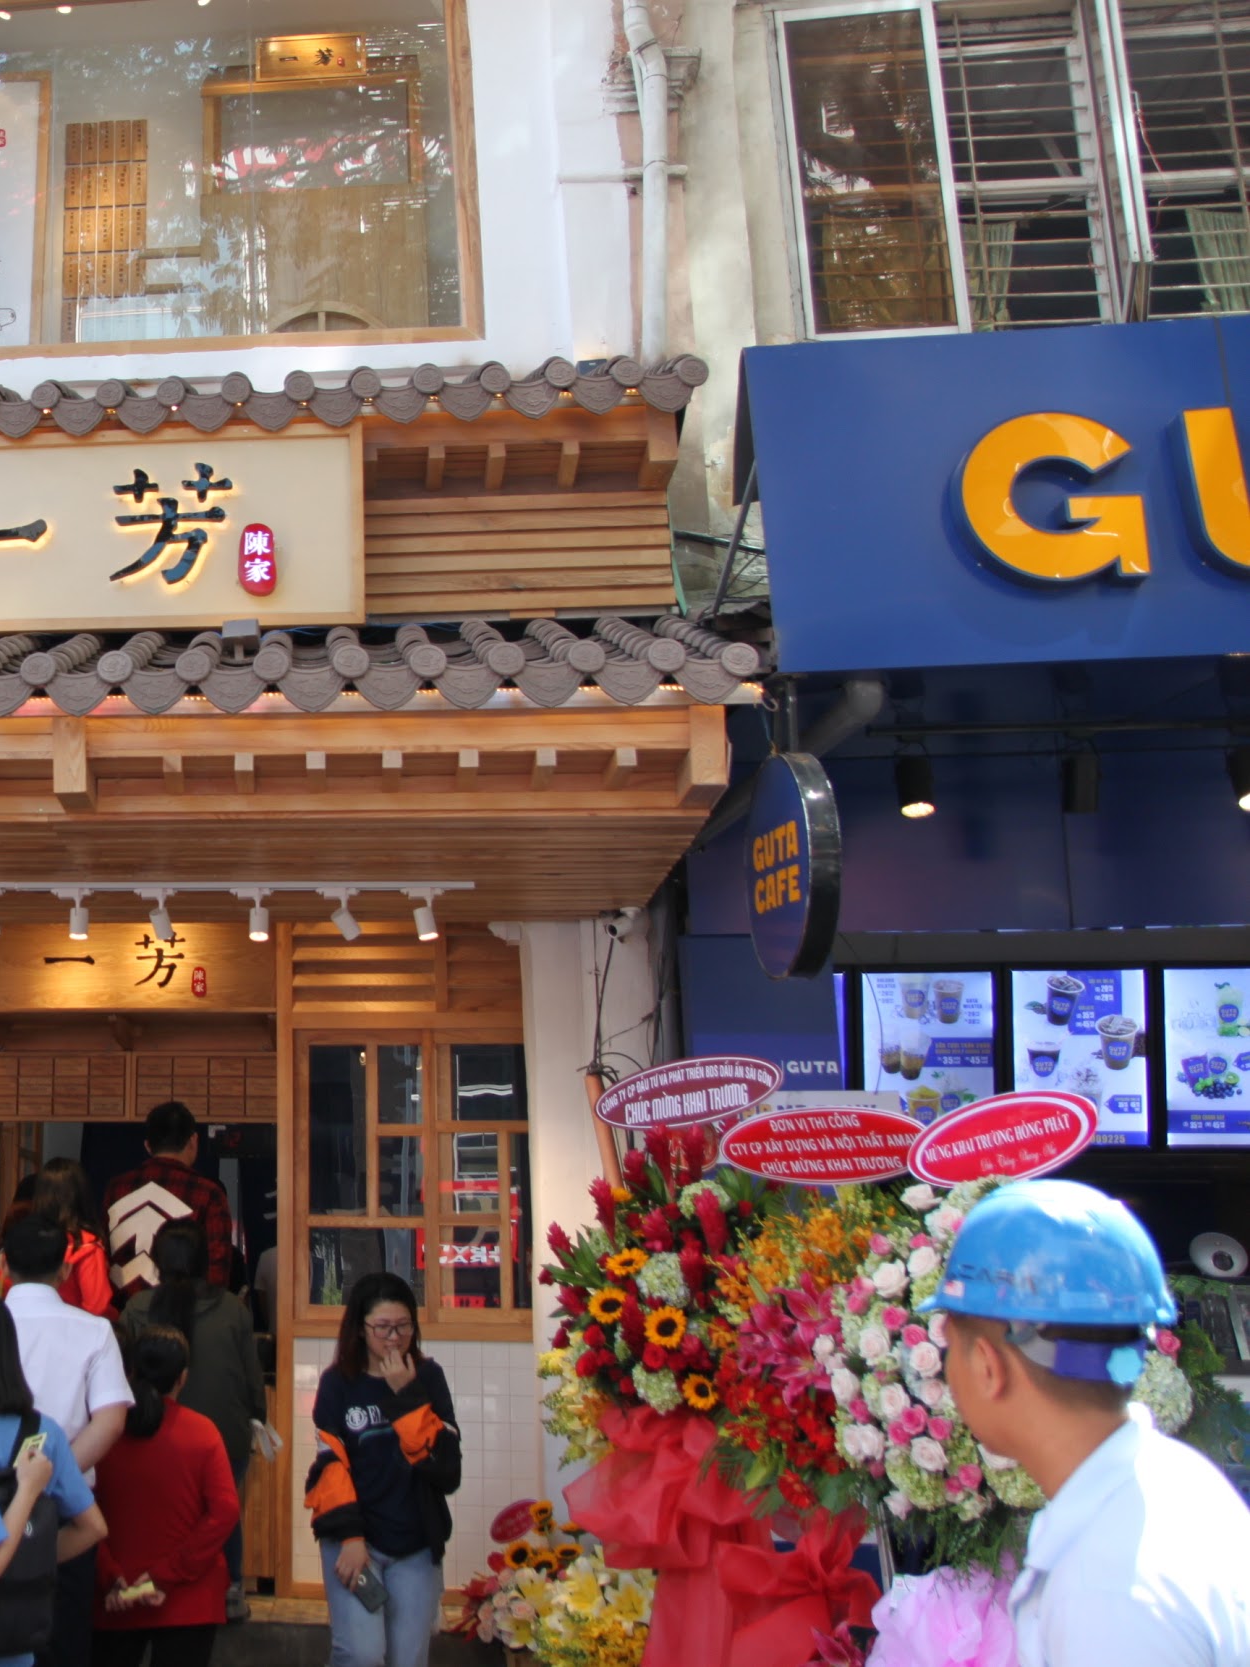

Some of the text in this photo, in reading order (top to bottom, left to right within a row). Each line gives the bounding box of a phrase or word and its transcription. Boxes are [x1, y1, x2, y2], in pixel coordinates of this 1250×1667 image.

[243, 530, 271, 583] 陳家
[753, 820, 798, 872] GUTA
[755, 864, 802, 914] CAFE
[44, 932, 186, 988] 一芳
[786, 1060, 839, 1074] GUTA
[601, 1096, 618, 1115] CÔNG
[618, 1092, 626, 1104] TY
[627, 1086, 636, 1099] CP
[658, 1069, 668, 1086] VÀ
[745, 1064, 756, 1080] SÀI
[757, 1068, 773, 1087] GÒN
[624, 1096, 650, 1125] CHÚC
[652, 1091, 681, 1120] MỪNG
[682, 1089, 707, 1116] KHAI
[708, 1083, 749, 1111] TRƯƠNG
[729, 1143, 748, 1156] CTY
[750, 1141, 763, 1155] CP
[764, 1137, 784, 1153] XÂY
[786, 1138, 817, 1155] DỰNG
[819, 1134, 835, 1149] VÀ
[834, 1133, 856, 1152] NỘI
[857, 1130, 885, 1148] THẤT
[769, 1112, 861, 1133] ĐƠN VỊ THI CÔNG
[760, 1155, 902, 1175] CHÚC MỪNG KHAI TRƯƠNG
[924, 1141, 952, 1163] MỪNG
[952, 1138, 975, 1159] KHAI
[974, 1127, 1014, 1149] TRƯƠNG
